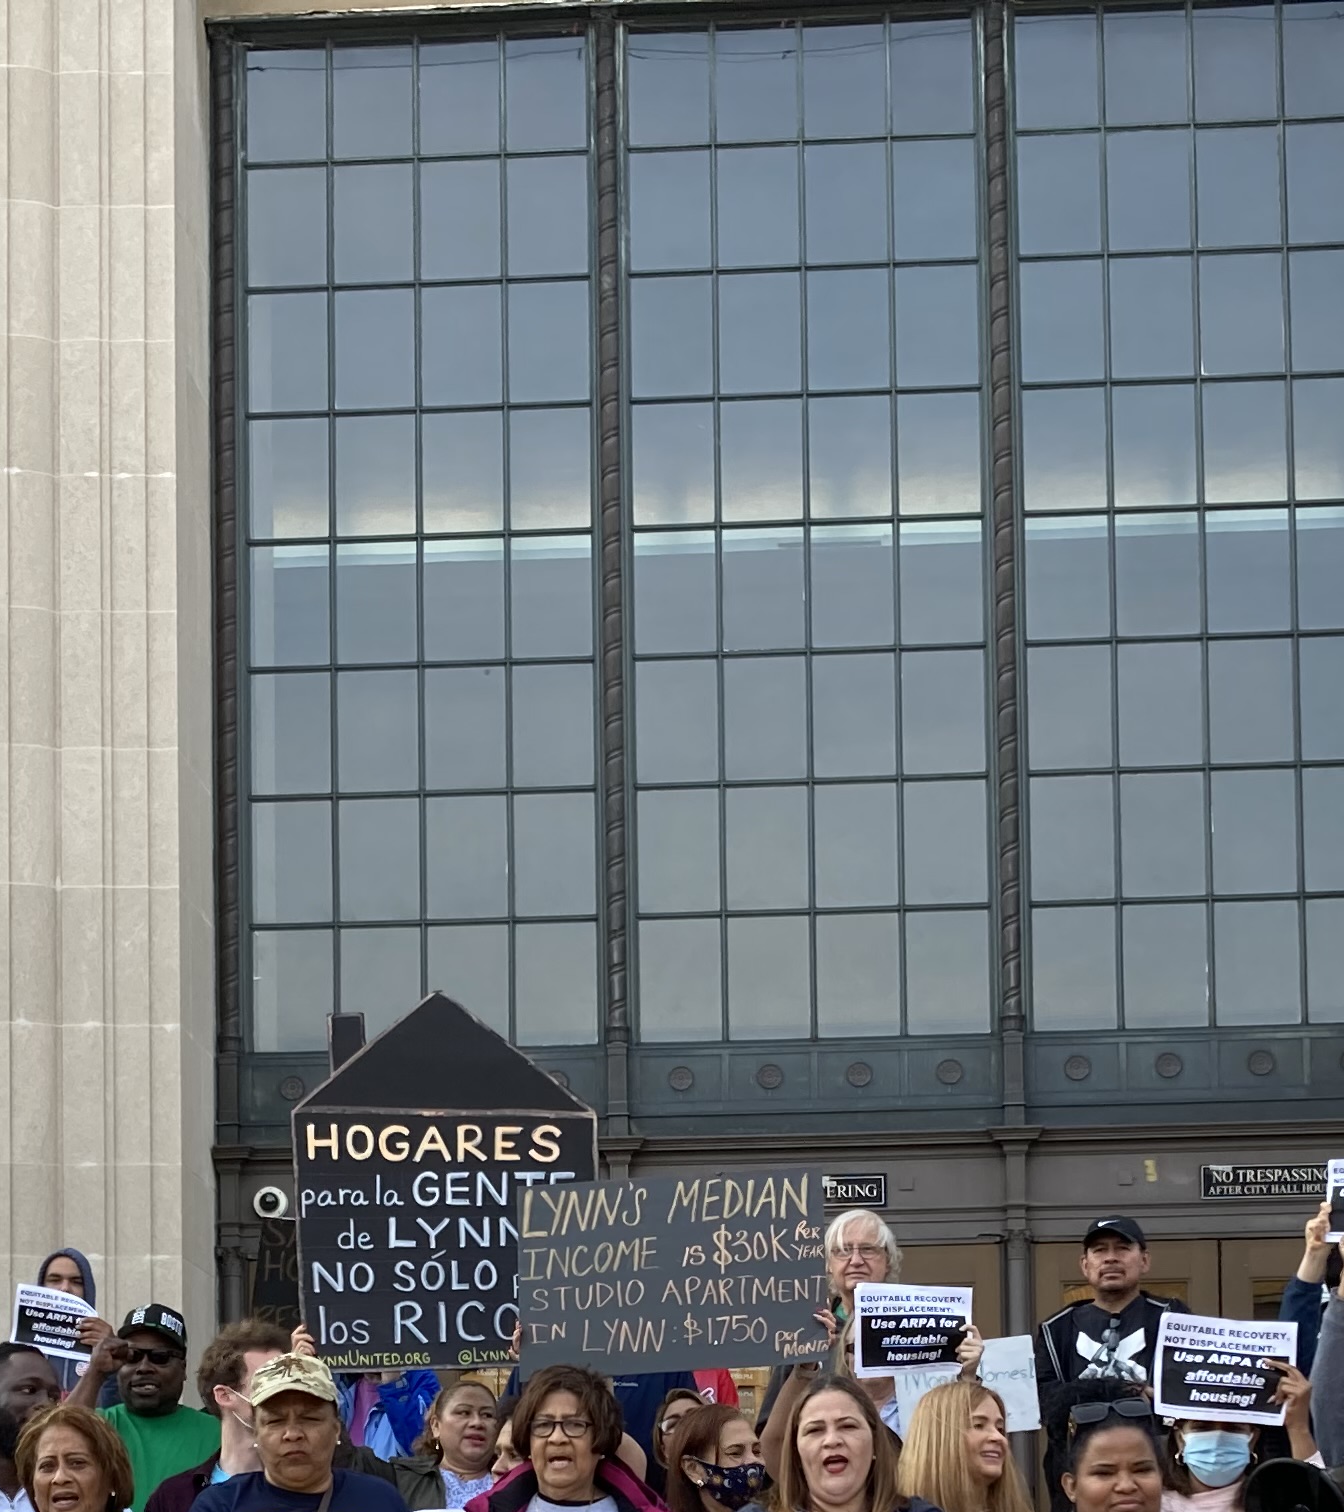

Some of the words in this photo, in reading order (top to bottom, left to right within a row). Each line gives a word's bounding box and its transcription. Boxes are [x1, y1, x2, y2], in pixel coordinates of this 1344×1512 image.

[306, 1123, 563, 1163] HOGARES
[1212, 1170, 1234, 1183] NO
[301, 1186, 370, 1218] para
[375, 1175, 404, 1206] la
[826, 1184, 877, 1198] ERING
[1208, 1185, 1242, 1195] AFTER
[1244, 1184, 1269, 1195] CITY
[1271, 1184, 1301, 1194] HALL
[667, 1173, 809, 1223] MEDIAN
[337, 1218, 374, 1250] de
[520, 1236, 660, 1281] INCOME
[681, 1246, 706, 1268] IS
[712, 1224, 792, 1275] $30K
[790, 1243, 825, 1260] YEAR
[312, 1261, 375, 1293] NO
[20, 1290, 59, 1300] EQUITABLE
[530, 1279, 645, 1312] STUDIO
[660, 1275, 827, 1306] APARTMENT
[25, 1308, 45, 1318] Use
[46, 1312, 73, 1323] ARPA
[870, 1318, 896, 1329] Use
[899, 1317, 937, 1329] ARPA
[939, 1317, 959, 1328] for
[318, 1305, 370, 1345] los
[530, 1322, 567, 1344] IN
[1167, 1322, 1226, 1336] EQUITABLE
[33, 1334, 76, 1349] housing!
[881, 1334, 949, 1346] affordable
[1164, 1335, 1186, 1344] NOT
[886, 1348, 942, 1362] housing!
[1173, 1351, 1205, 1363] Use
[1207, 1353, 1252, 1367] ARPA
[1184, 1370, 1266, 1387] affordable
[1189, 1389, 1256, 1407] housing!
